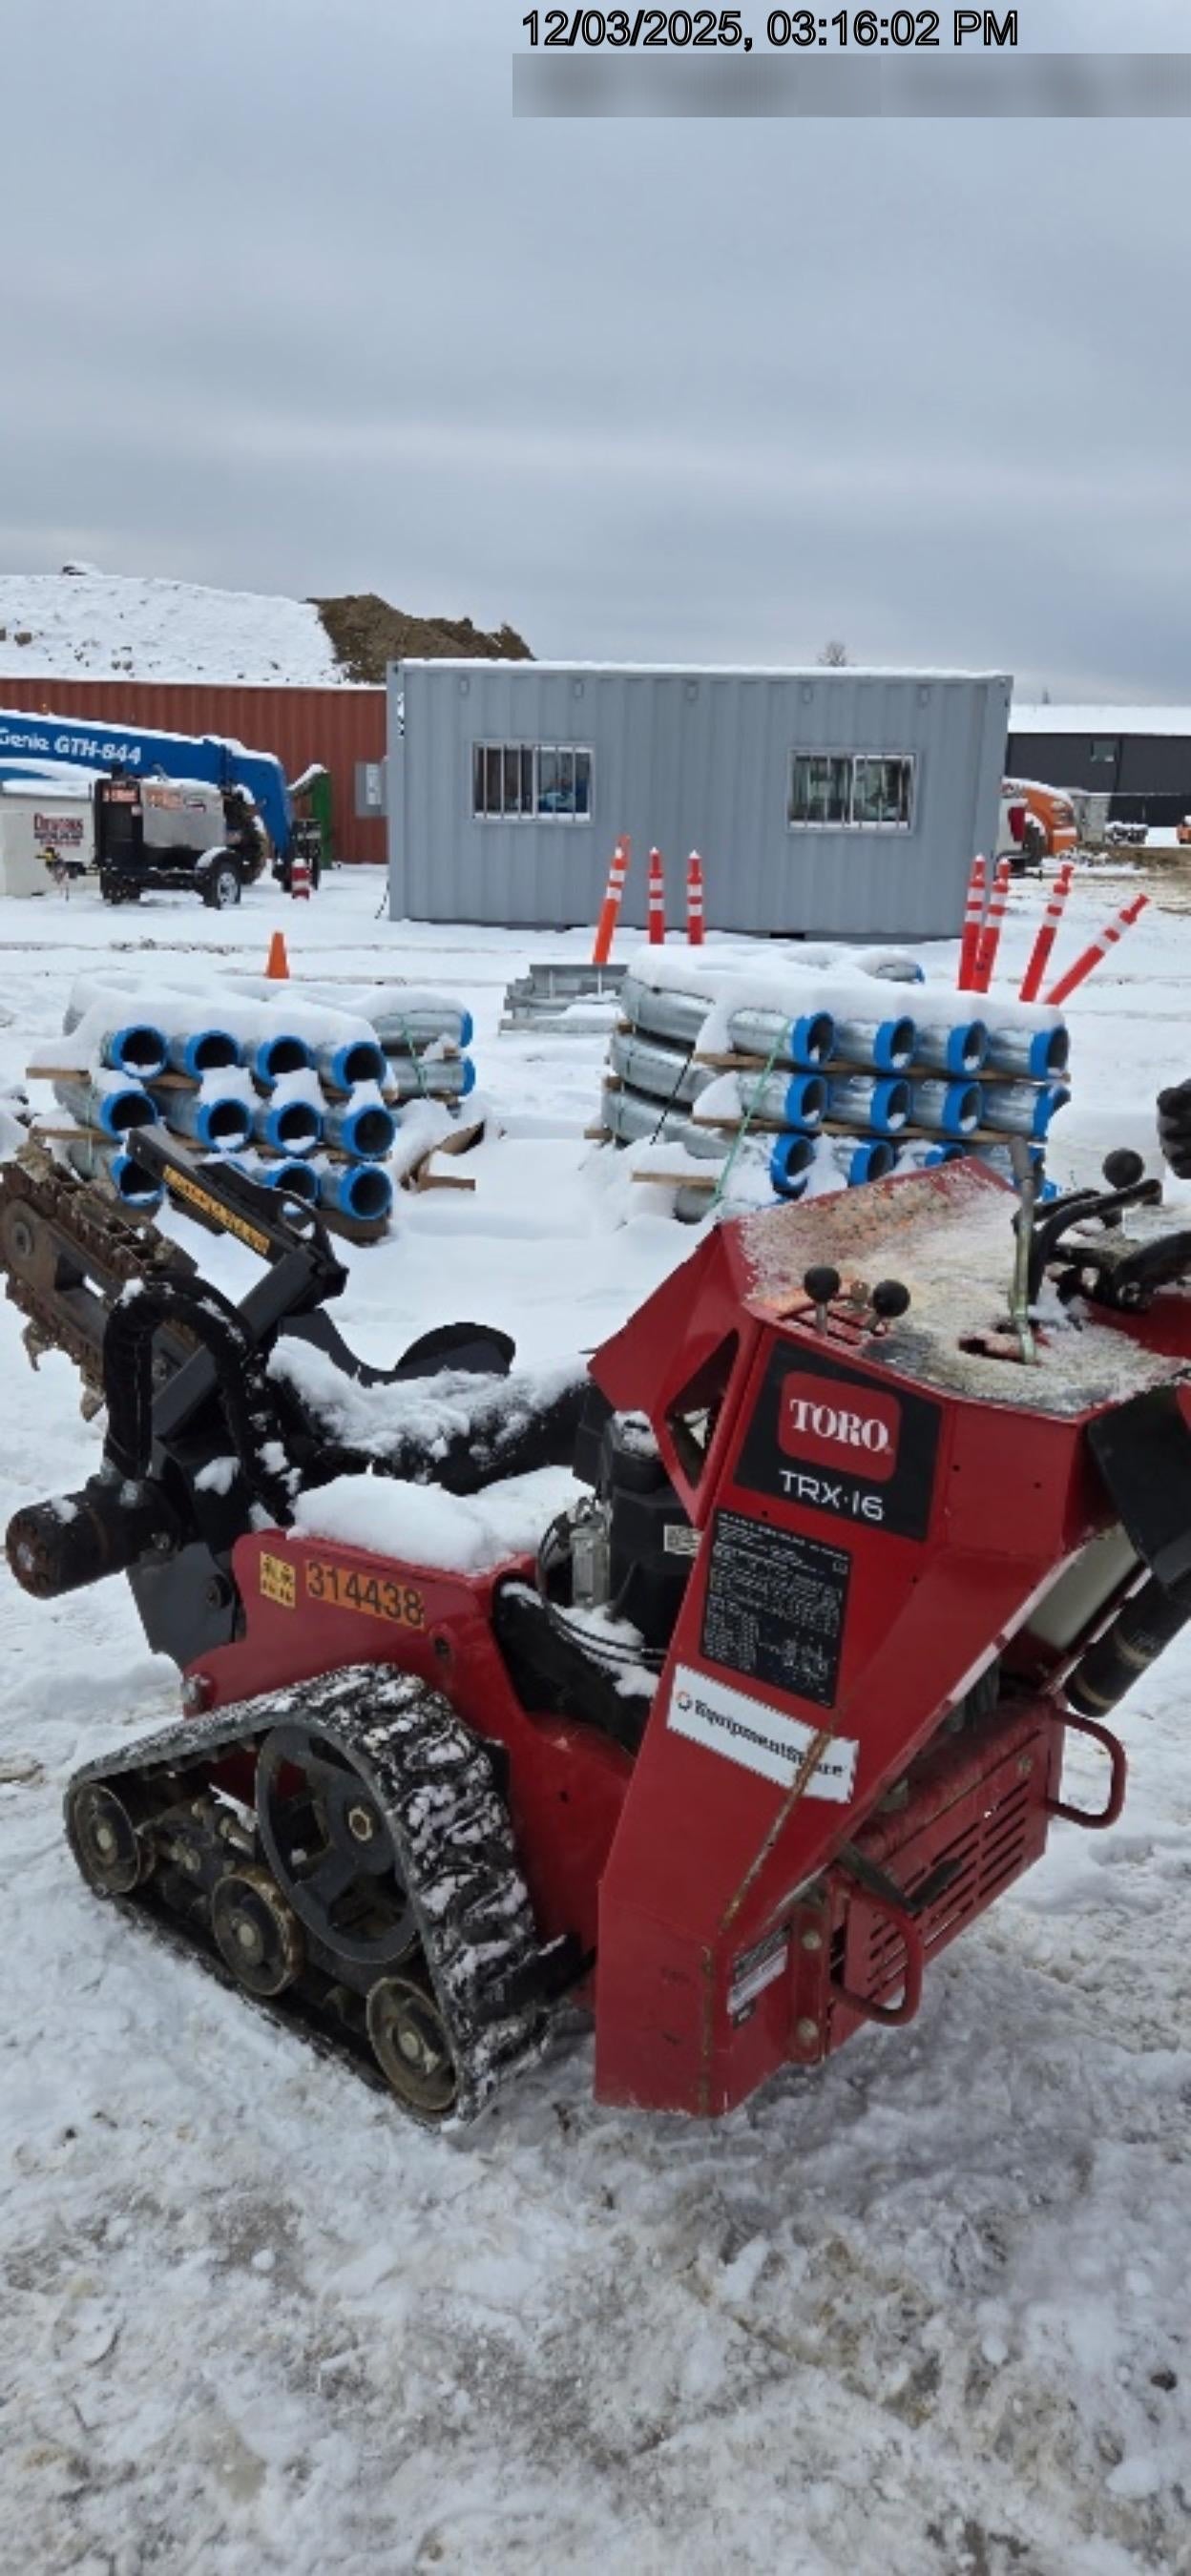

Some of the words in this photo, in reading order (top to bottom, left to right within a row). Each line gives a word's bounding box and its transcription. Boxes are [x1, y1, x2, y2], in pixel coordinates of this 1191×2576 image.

[54, 735, 142, 765] GTH-844
[790, 1399, 888, 1453] TORO
[307, 1561, 424, 1626] 314438
[695, 1699, 844, 1777] EquipmentShre
